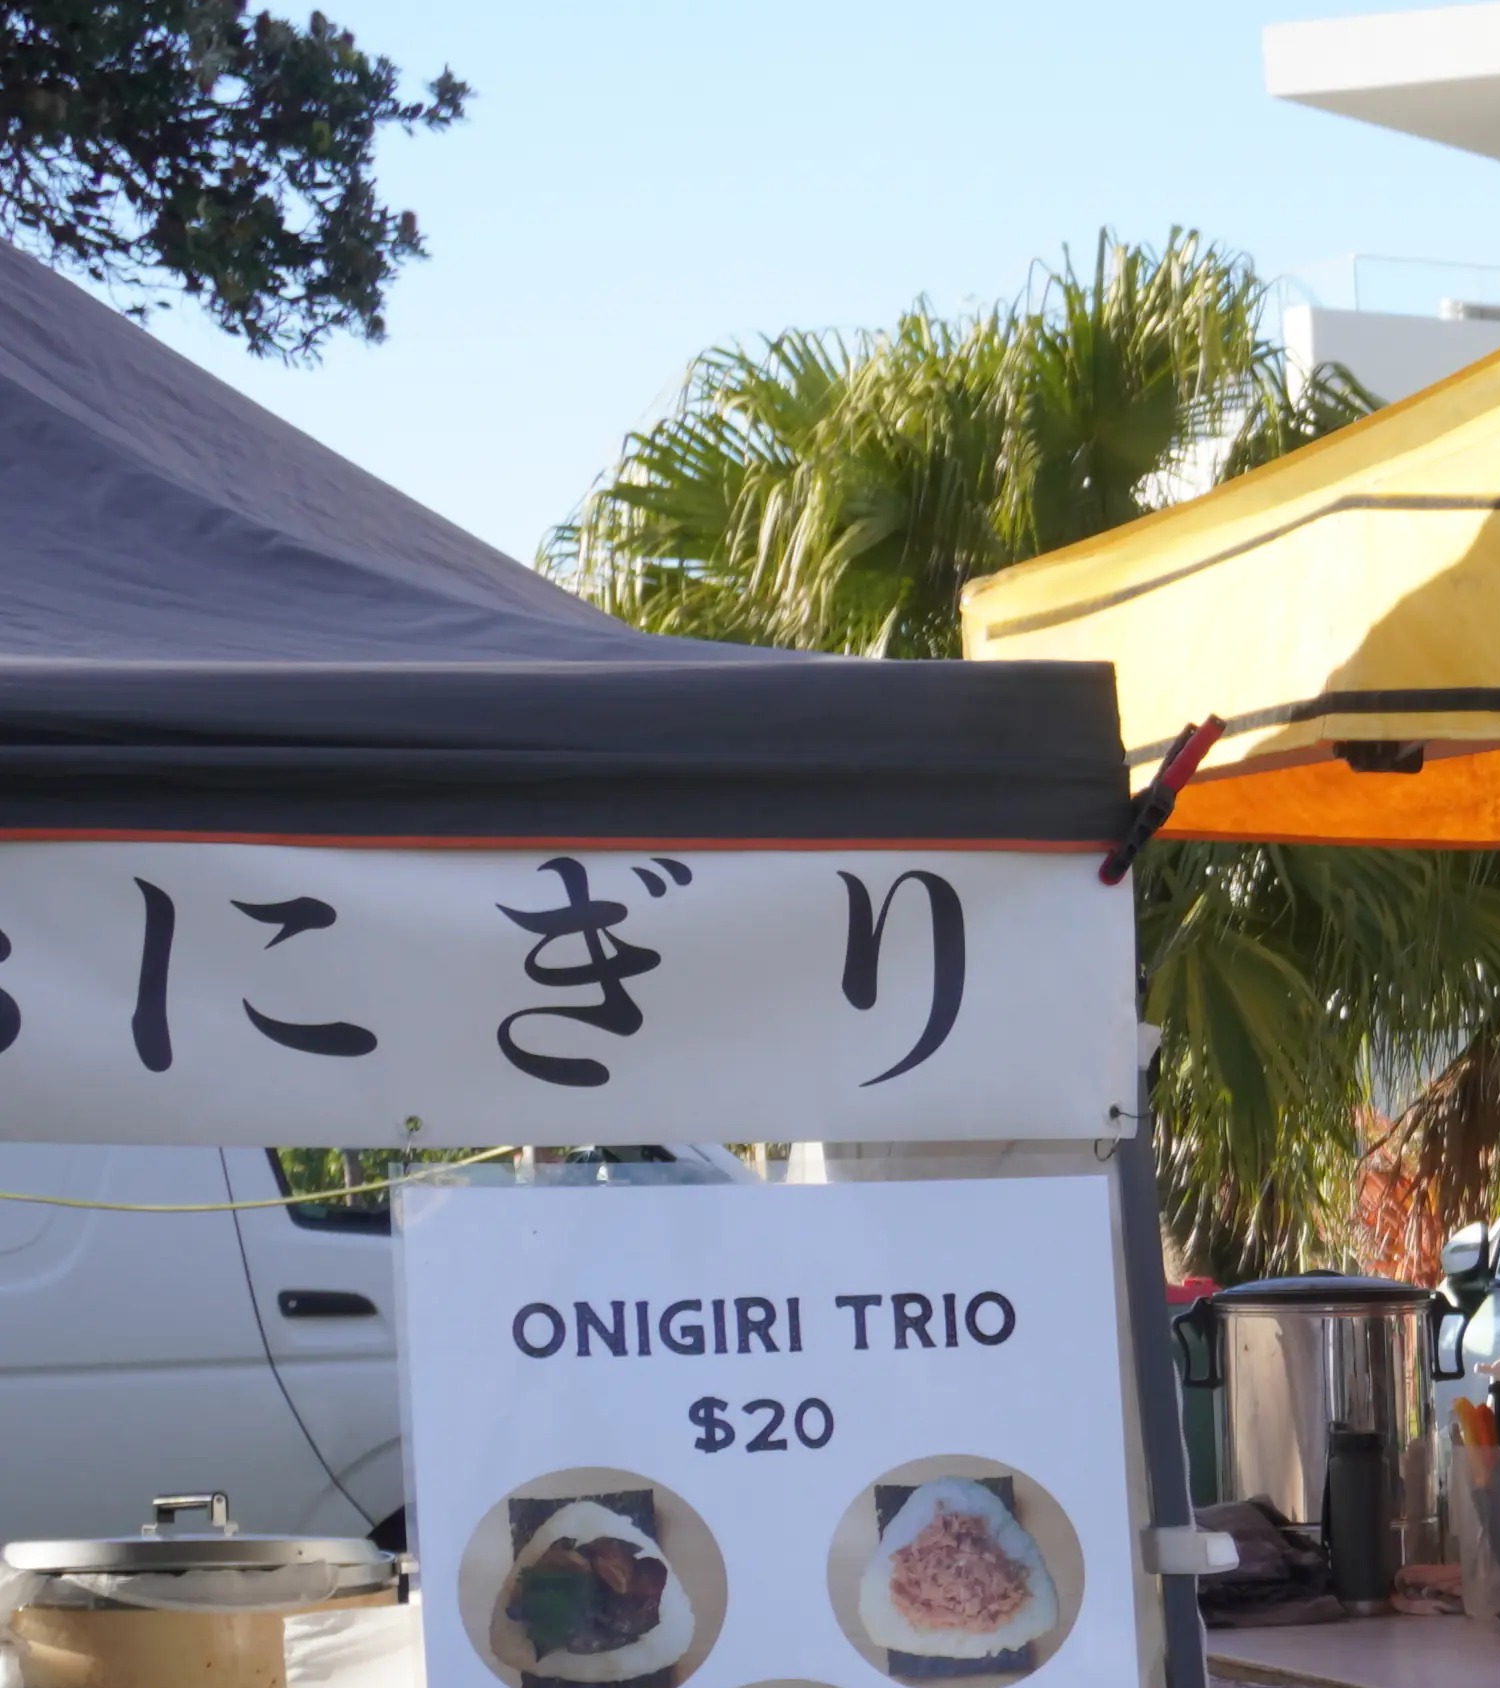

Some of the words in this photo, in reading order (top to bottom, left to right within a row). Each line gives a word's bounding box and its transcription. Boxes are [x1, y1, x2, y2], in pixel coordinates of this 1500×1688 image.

[0, 853, 966, 1089] にぎり
[512, 1296, 803, 1359] ONIGIRI
[834, 1290, 1017, 1350] TRIO
[688, 1396, 835, 1453] $20
